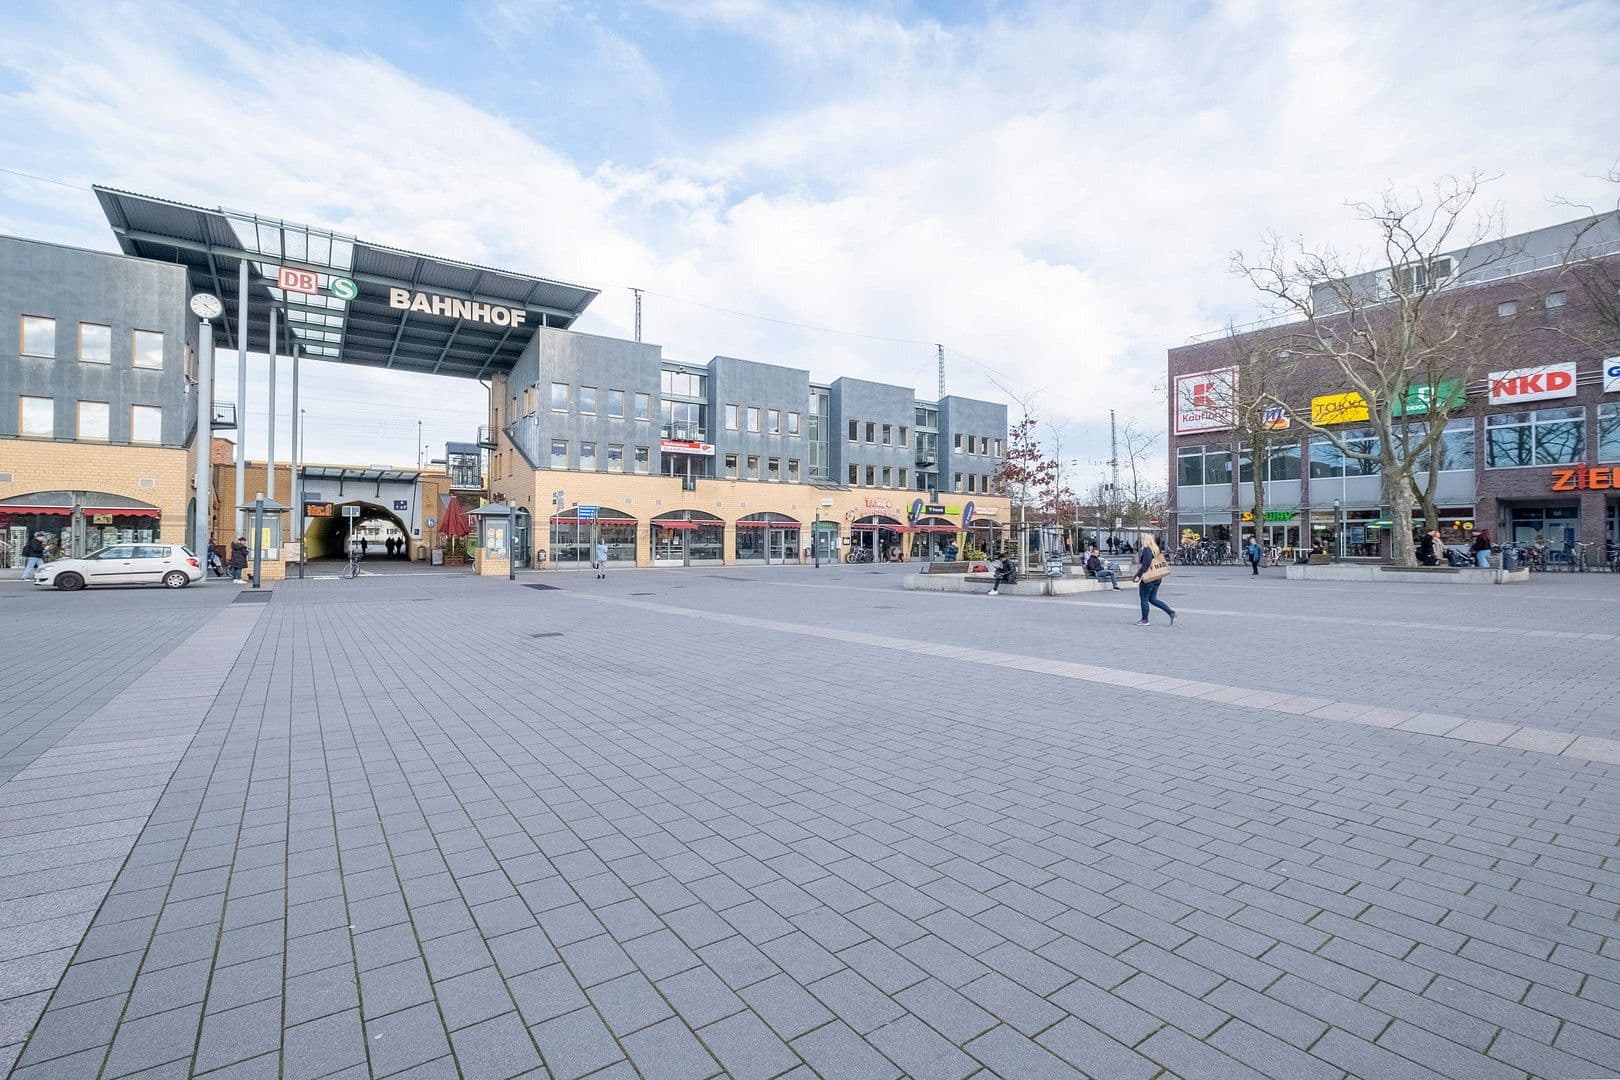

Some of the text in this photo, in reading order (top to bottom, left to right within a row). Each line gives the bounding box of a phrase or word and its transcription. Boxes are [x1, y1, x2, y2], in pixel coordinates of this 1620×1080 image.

[284, 271, 313, 290] DB
[334, 280, 354, 297] S
[390, 287, 526, 328] BAHNHOF
[1492, 371, 1572, 397] NKD
